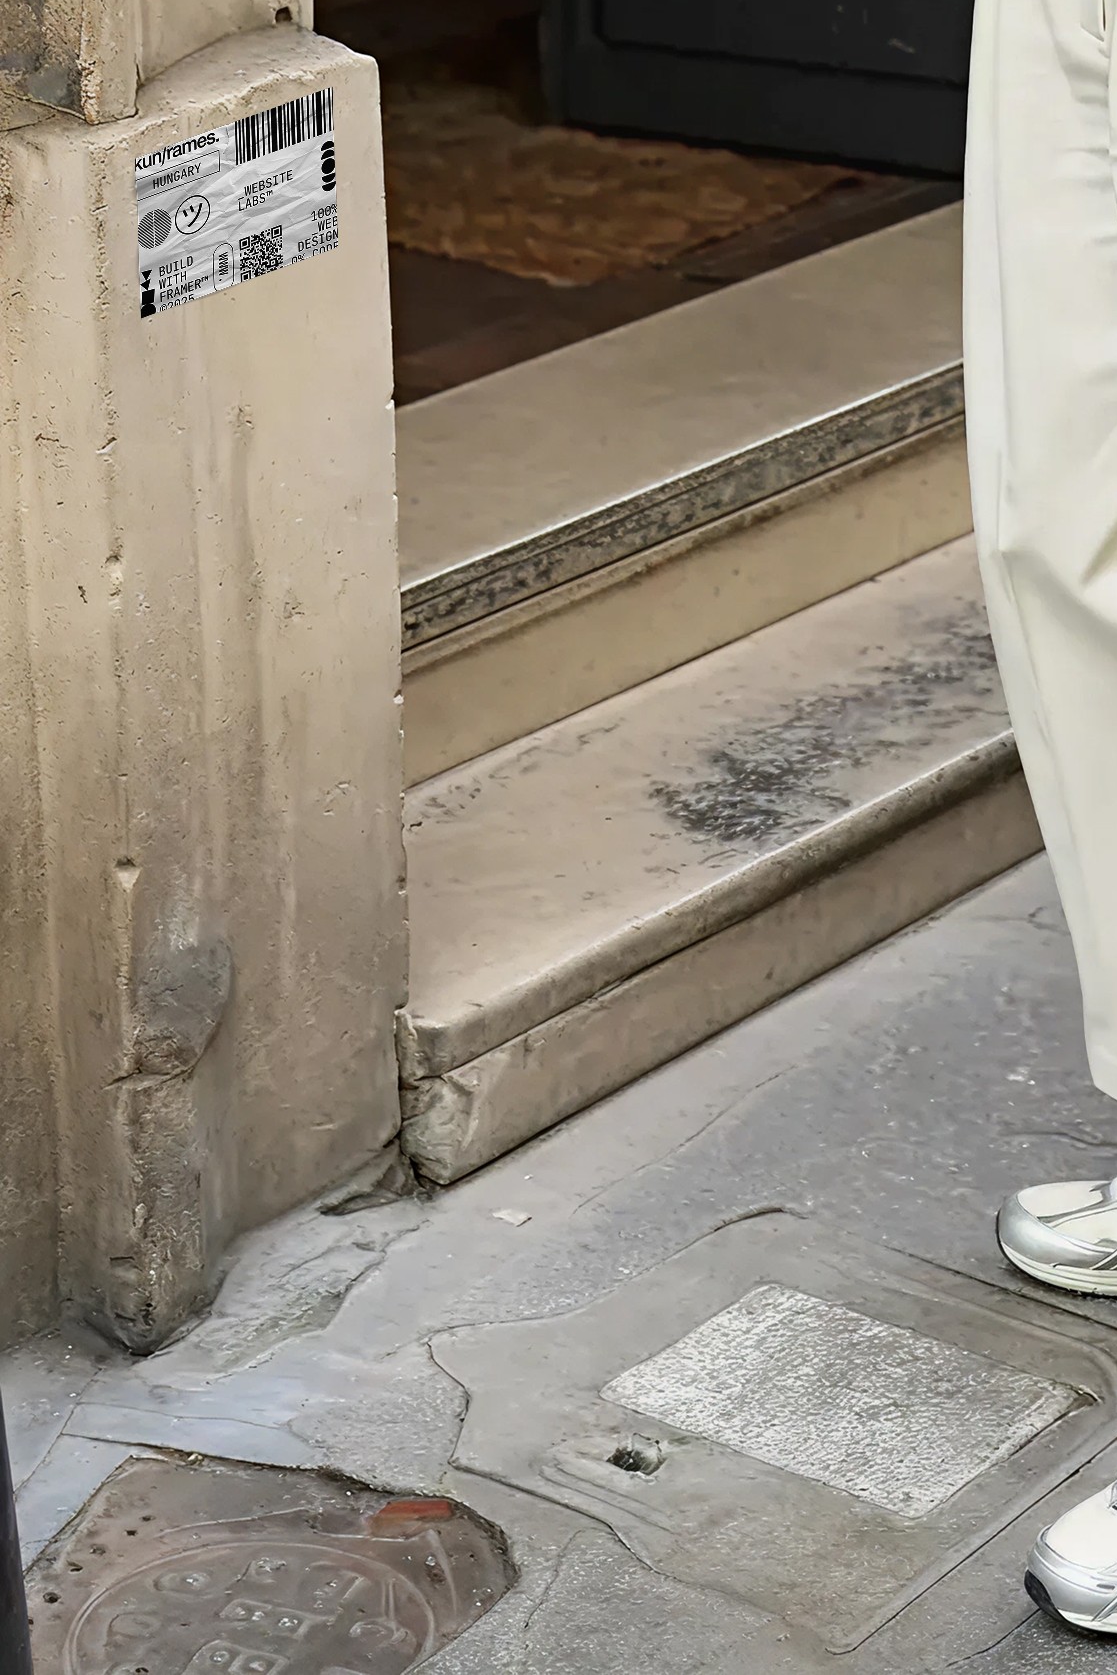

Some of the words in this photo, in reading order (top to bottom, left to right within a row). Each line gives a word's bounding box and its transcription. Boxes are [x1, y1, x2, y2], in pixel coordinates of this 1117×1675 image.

[152, 162, 201, 189] HUNGARY
[298, 228, 338, 252] DESIGN
[159, 256, 193, 277] BUILD
[159, 271, 186, 289] WITH
[160, 276, 209, 302] FRAMER™
